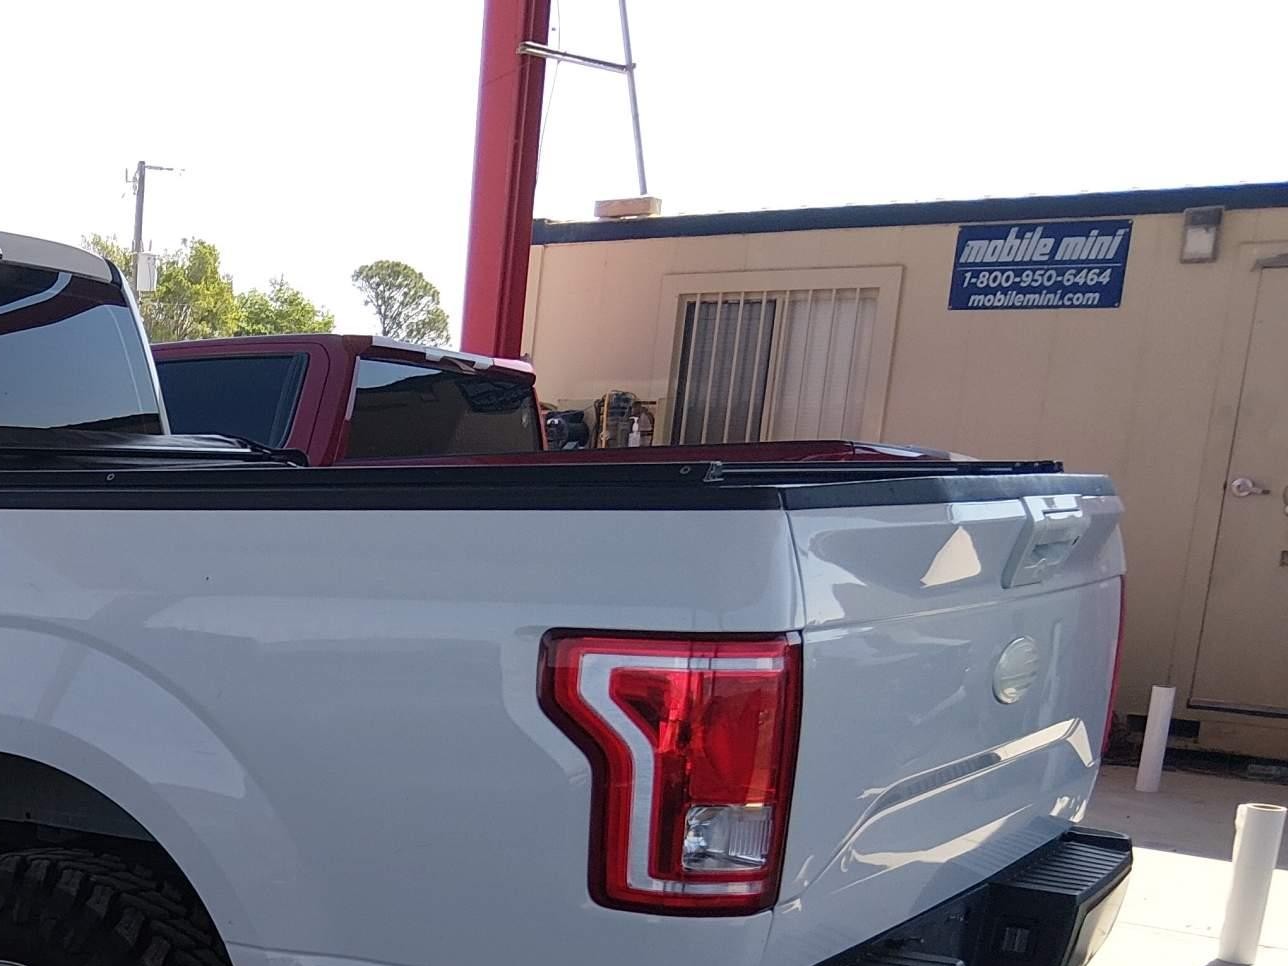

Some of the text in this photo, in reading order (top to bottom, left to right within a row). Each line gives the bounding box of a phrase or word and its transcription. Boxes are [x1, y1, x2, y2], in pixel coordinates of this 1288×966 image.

[960, 227, 1125, 263] mobile mini
[963, 269, 1112, 288] 1-800-950-6464
[968, 290, 1100, 307] mobilemini.com
